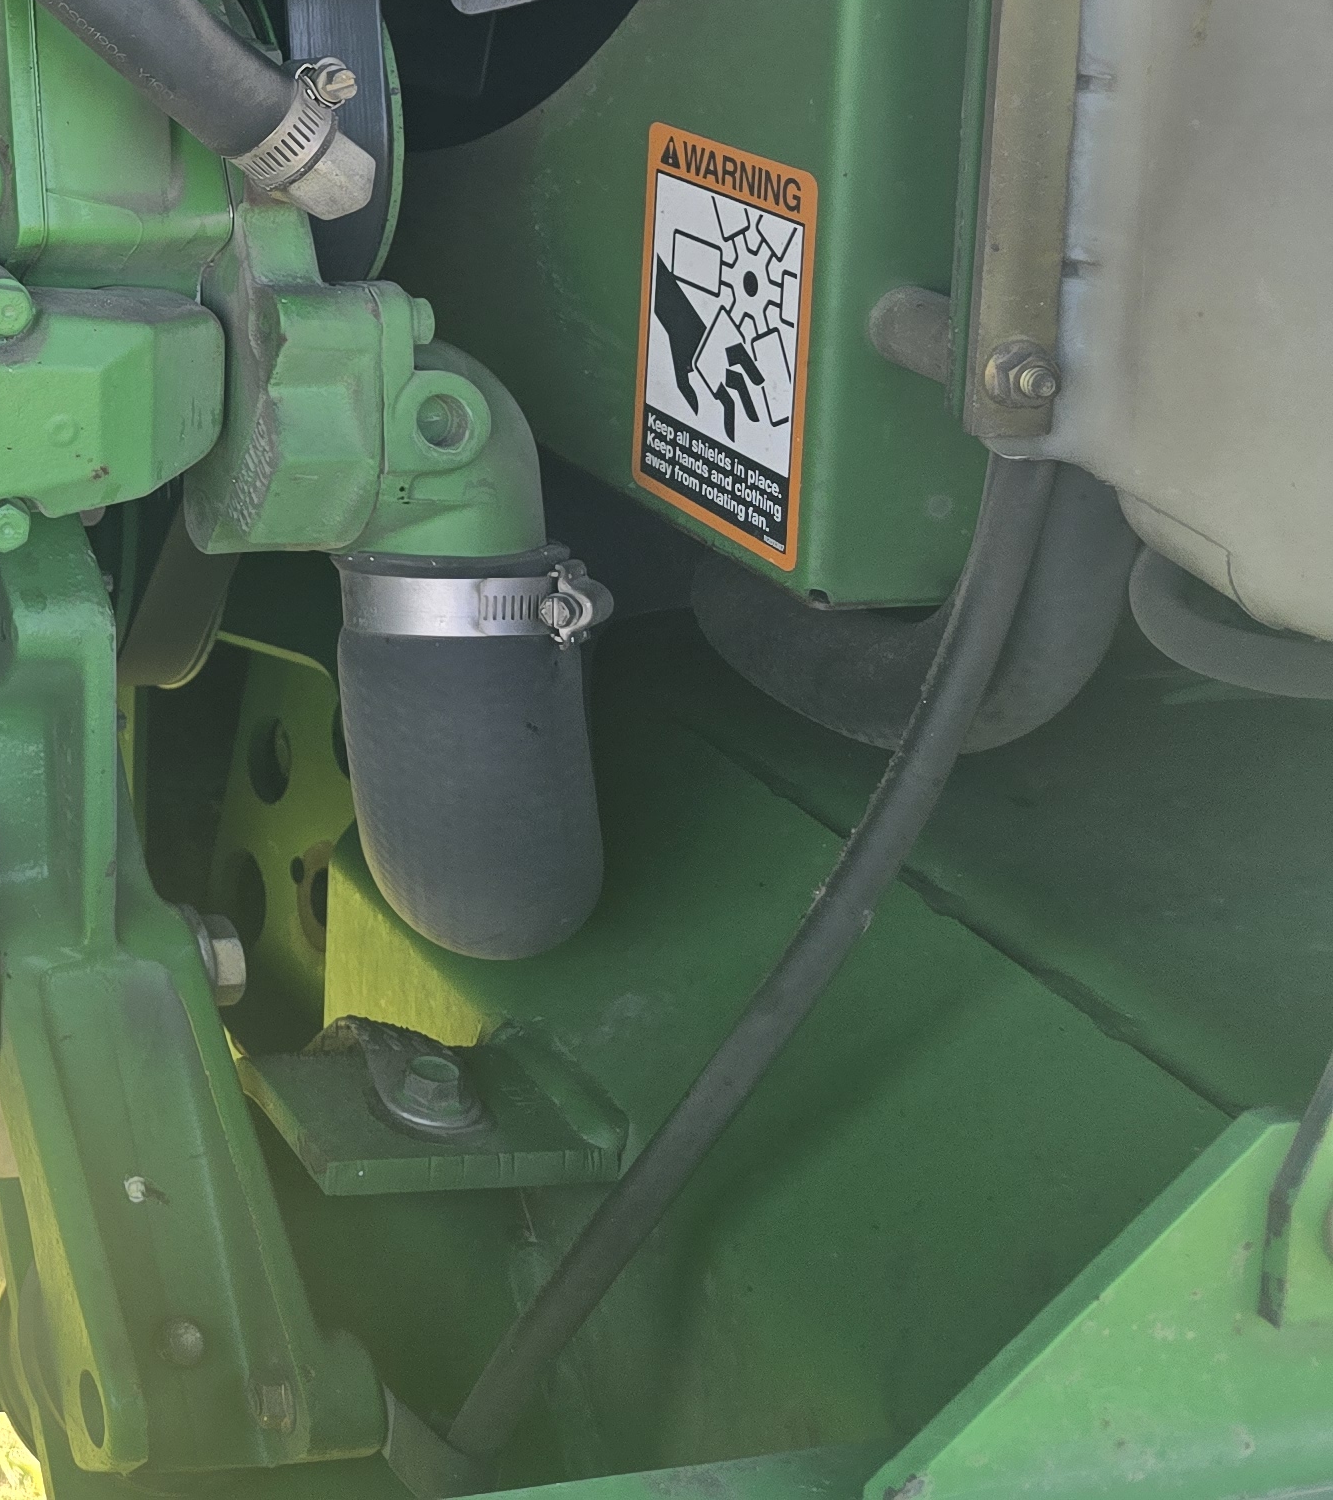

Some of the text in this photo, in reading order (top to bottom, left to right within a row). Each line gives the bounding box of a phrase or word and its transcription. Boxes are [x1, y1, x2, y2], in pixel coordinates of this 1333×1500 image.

[682, 139, 803, 214] WARNING
[645, 452, 770, 532] away from rotating fan.
[646, 430, 782, 522] Keep hands and clothing
[647, 412, 783, 499] Keep all shields in place.
